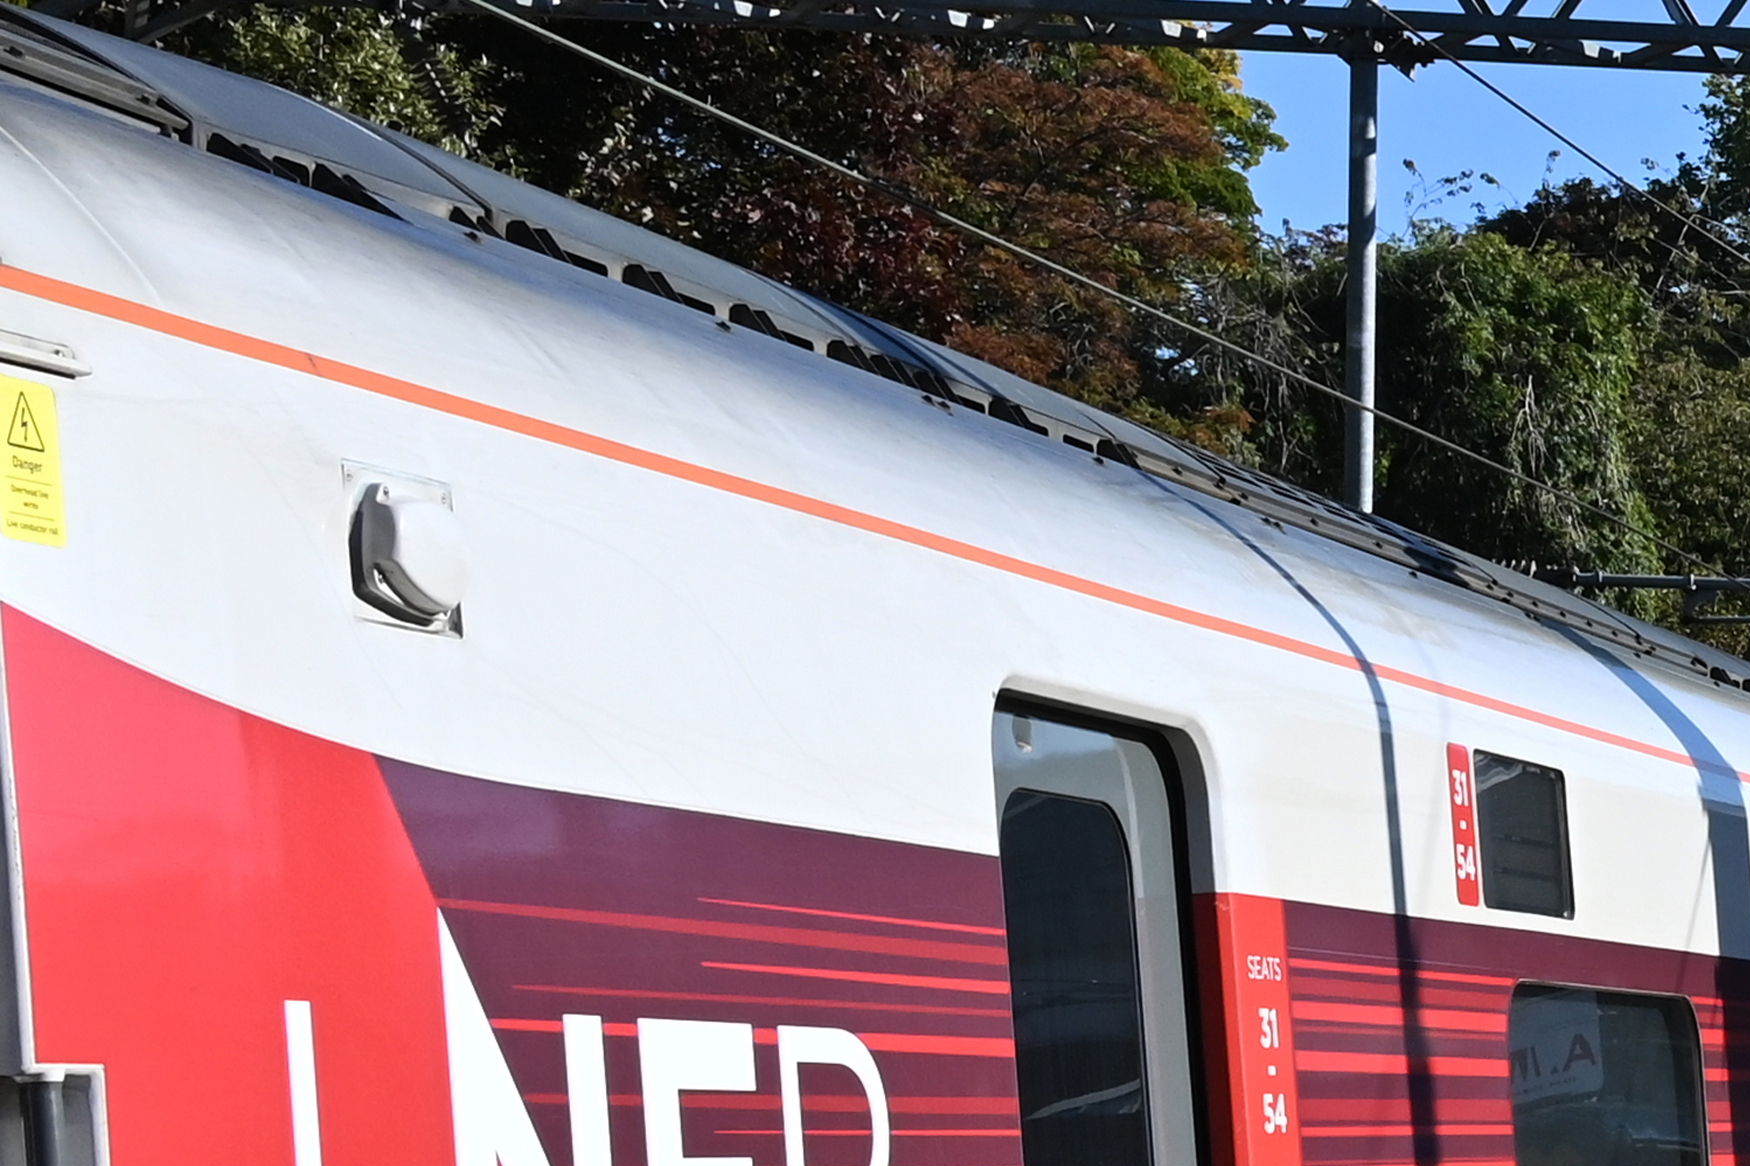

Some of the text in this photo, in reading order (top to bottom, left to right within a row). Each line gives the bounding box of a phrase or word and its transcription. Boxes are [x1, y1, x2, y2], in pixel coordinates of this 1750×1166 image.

[12, 454, 43, 475] Danger
[1451, 768, 1470, 807] 31
[1455, 843, 1476, 882] 54
[1246, 954, 1283, 982] SEATS
[1258, 1007, 1280, 1049] 31
[1262, 1092, 1288, 1134] 54
